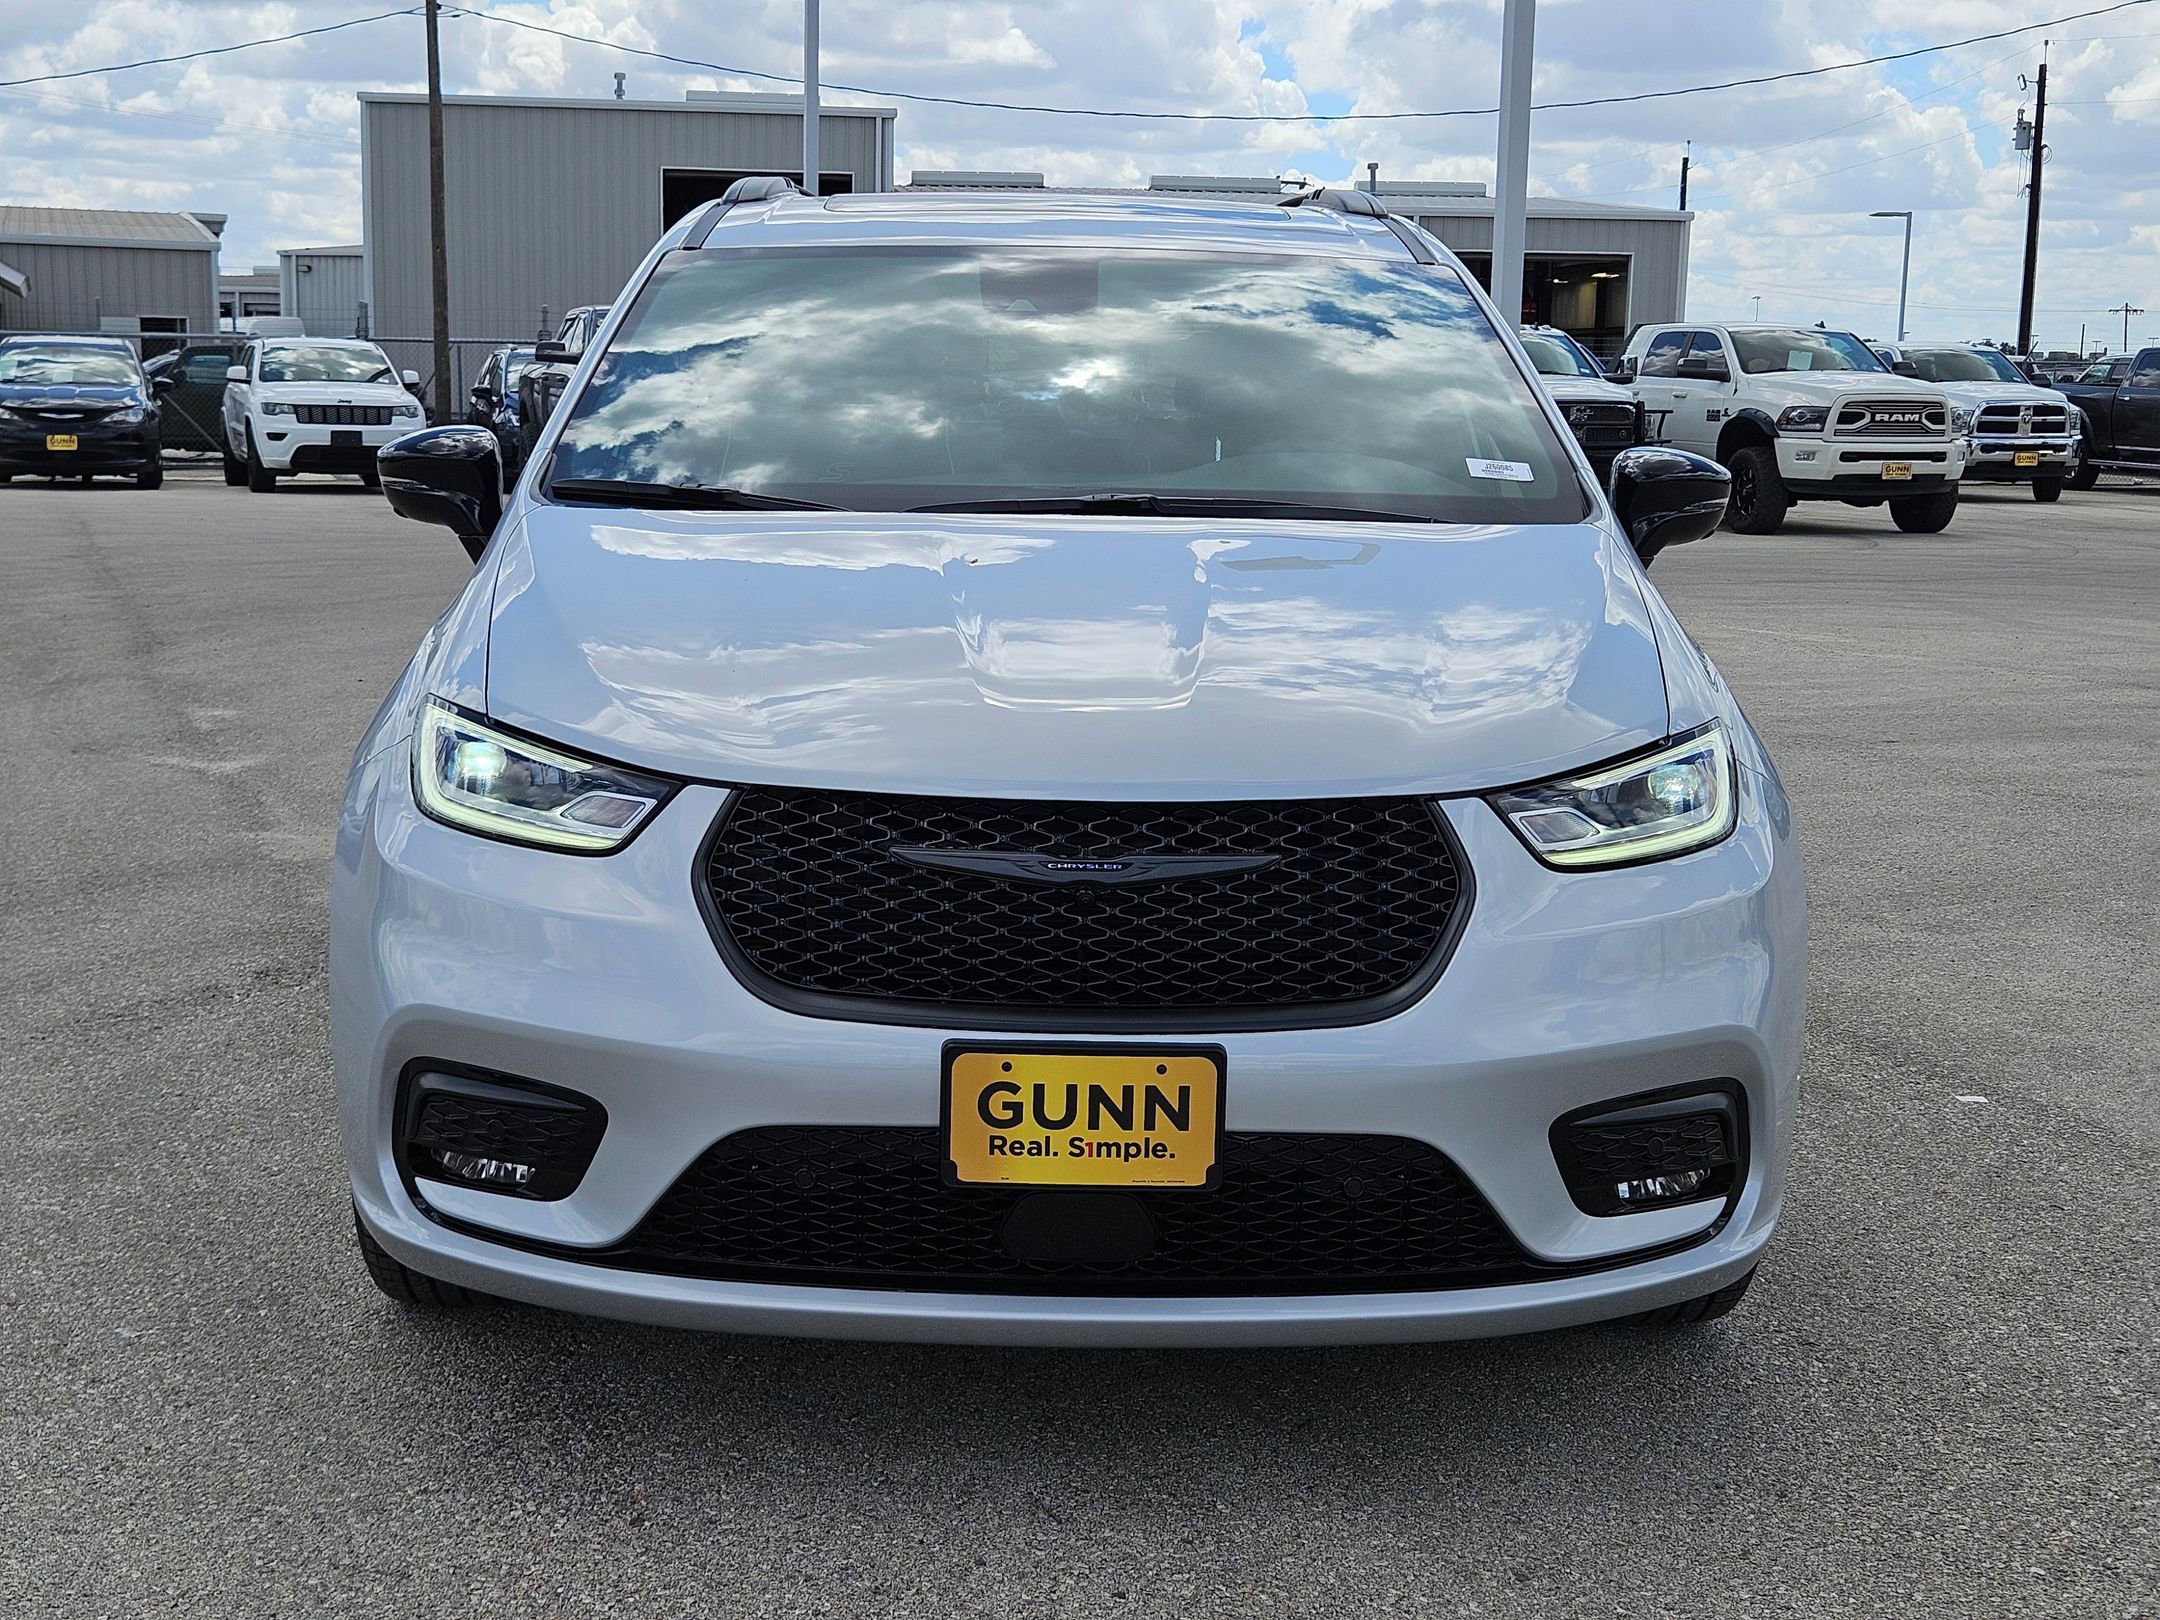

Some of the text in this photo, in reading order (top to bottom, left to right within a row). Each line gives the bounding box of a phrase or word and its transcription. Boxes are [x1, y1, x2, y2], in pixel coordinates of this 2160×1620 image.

[1885, 465, 1910, 473] GUNN
[977, 1080, 1191, 1132] GUNN
[988, 1135, 1059, 1157] Real.
